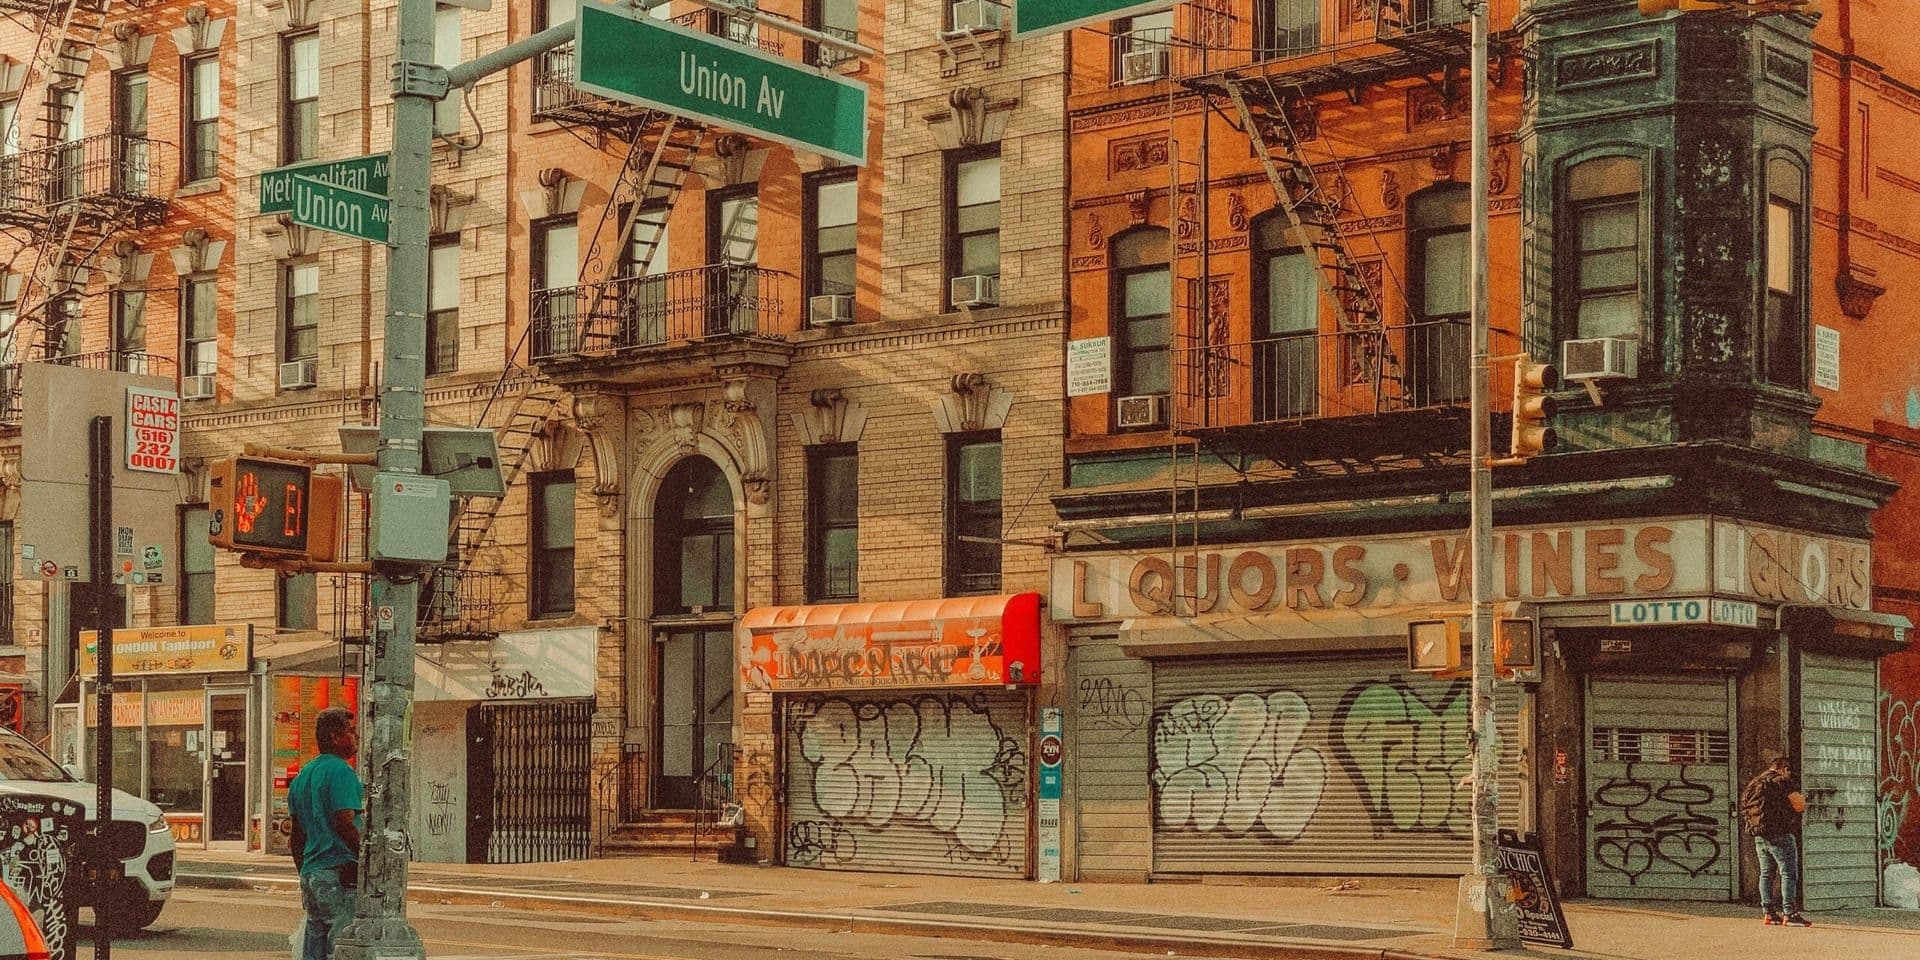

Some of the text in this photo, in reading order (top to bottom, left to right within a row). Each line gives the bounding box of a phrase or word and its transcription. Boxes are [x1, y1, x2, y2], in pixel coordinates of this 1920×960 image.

[680, 51, 784, 119] Union Av
[297, 184, 388, 233] Union Av
[133, 396, 178, 414] CASH 4
[132, 412, 176, 431] CARS
[135, 428, 174, 444] (516)
[136, 442, 171, 457] 232
[130, 454, 176, 470] 0007
[1430, 526, 1675, 600] WINES
[1718, 524, 1867, 609] LIQUORS
[1613, 600, 1701, 623] LOTTO
[1712, 600, 1754, 625] LOTTO
[140, 630, 186, 640] Welcome to
[113, 640, 215, 654] LONDON Tandoori
[1042, 745, 1060, 754] ZYN
